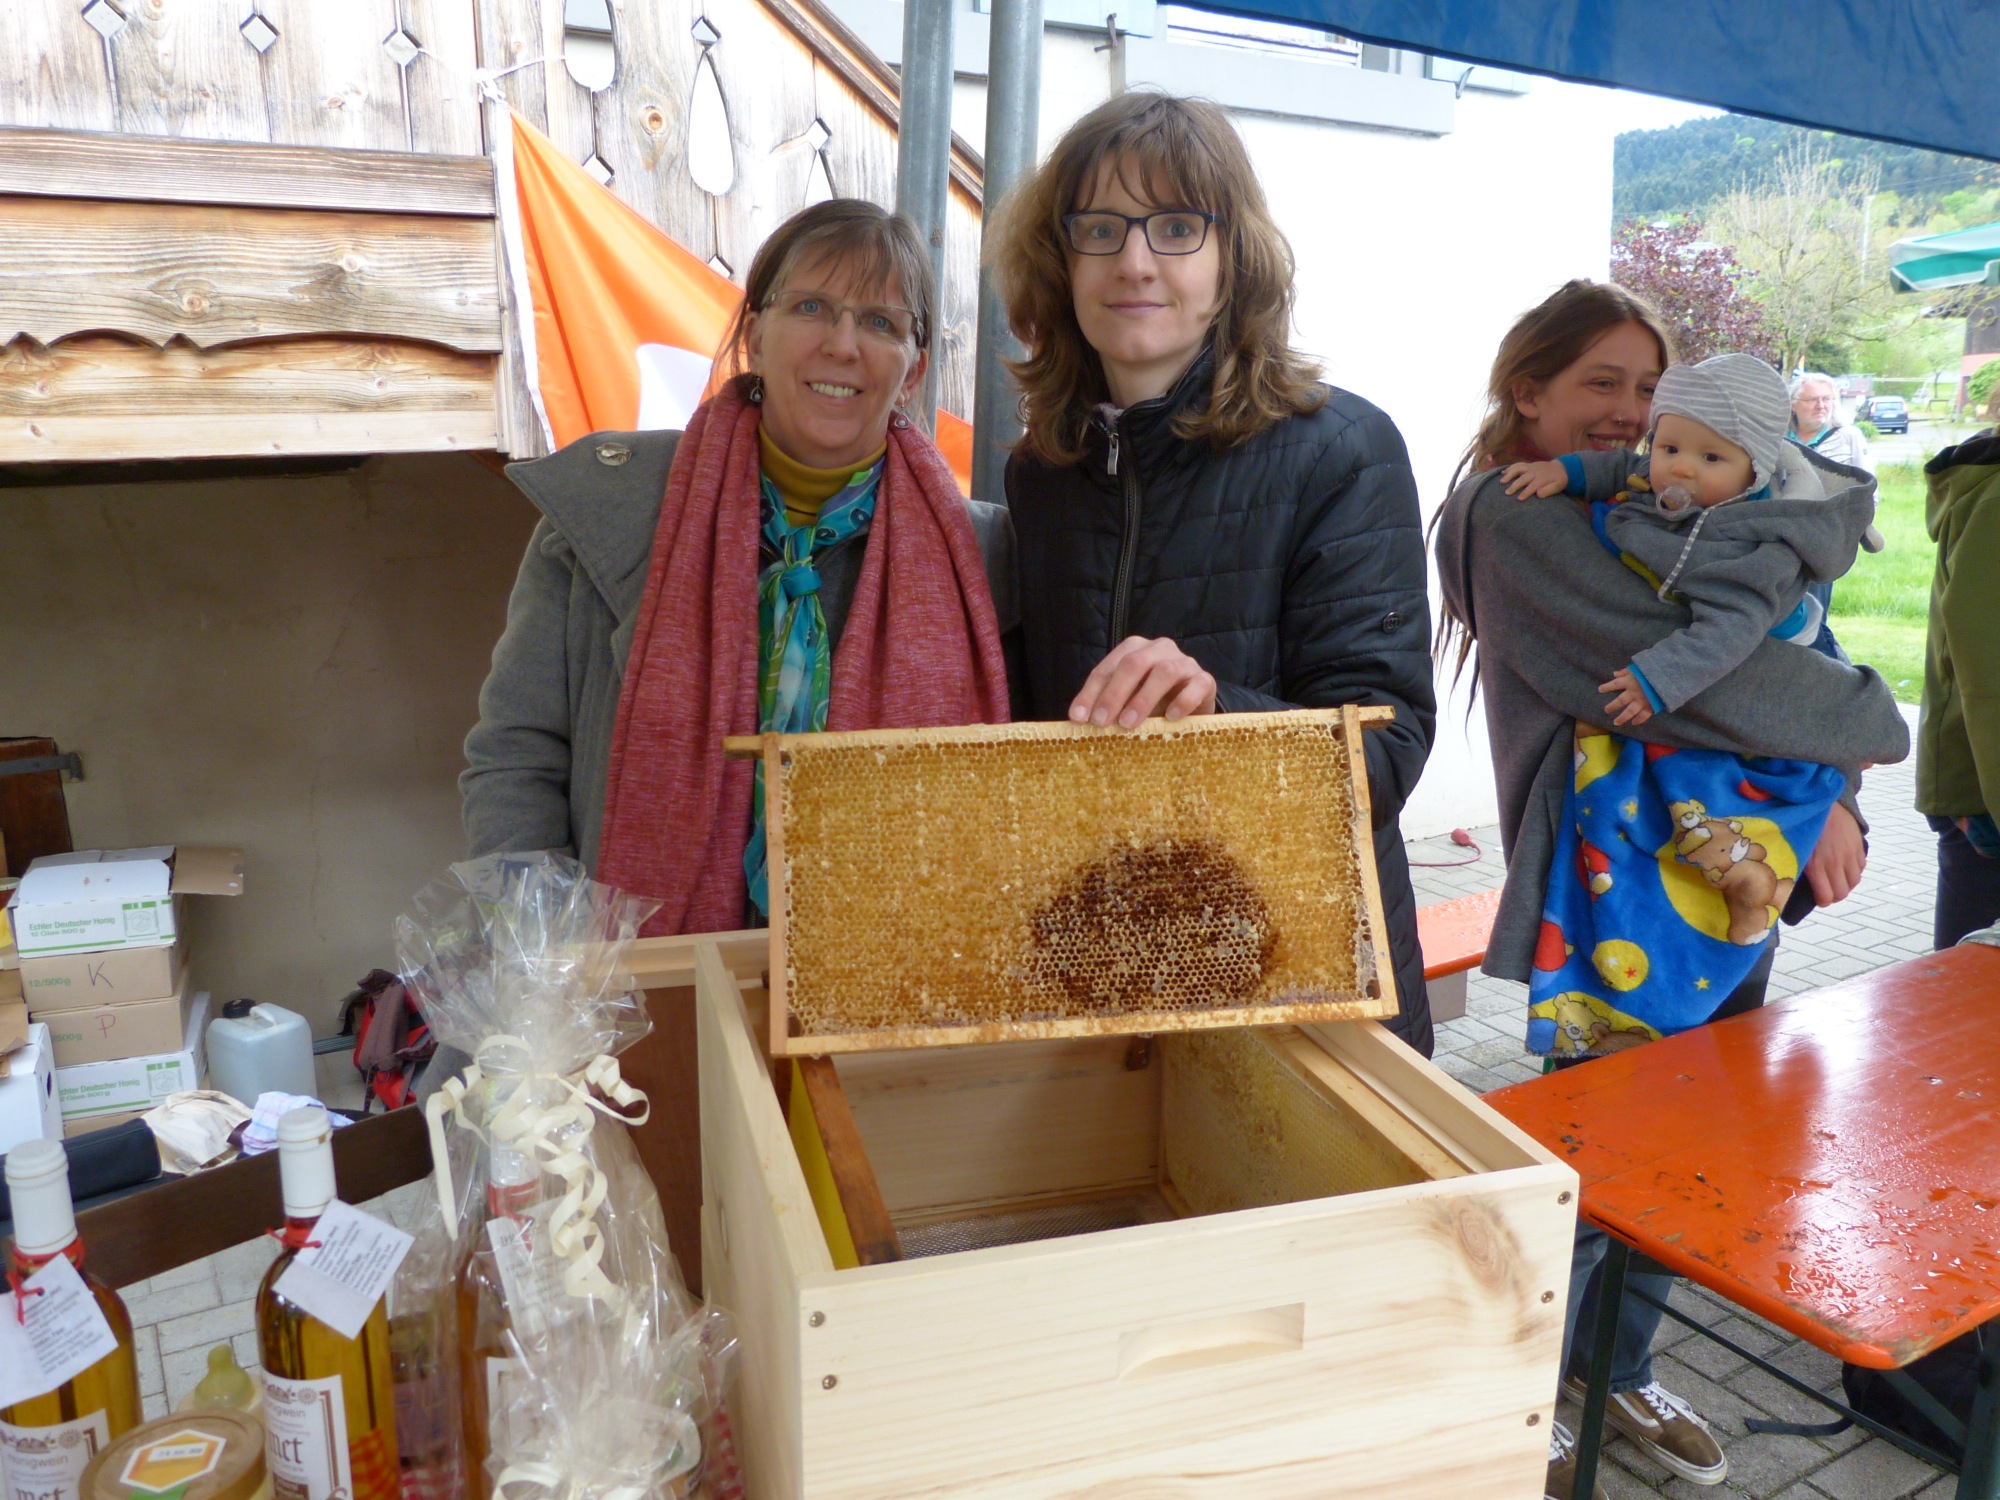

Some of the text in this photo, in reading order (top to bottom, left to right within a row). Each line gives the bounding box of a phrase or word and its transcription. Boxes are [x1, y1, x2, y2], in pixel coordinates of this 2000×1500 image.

[54, 919, 92, 929] Deutscher
[93, 916, 116, 925] Honig
[87, 961, 114, 989] K
[95, 1014, 117, 1039] P
[58, 1079, 140, 1096] chter Deutscher Honig
